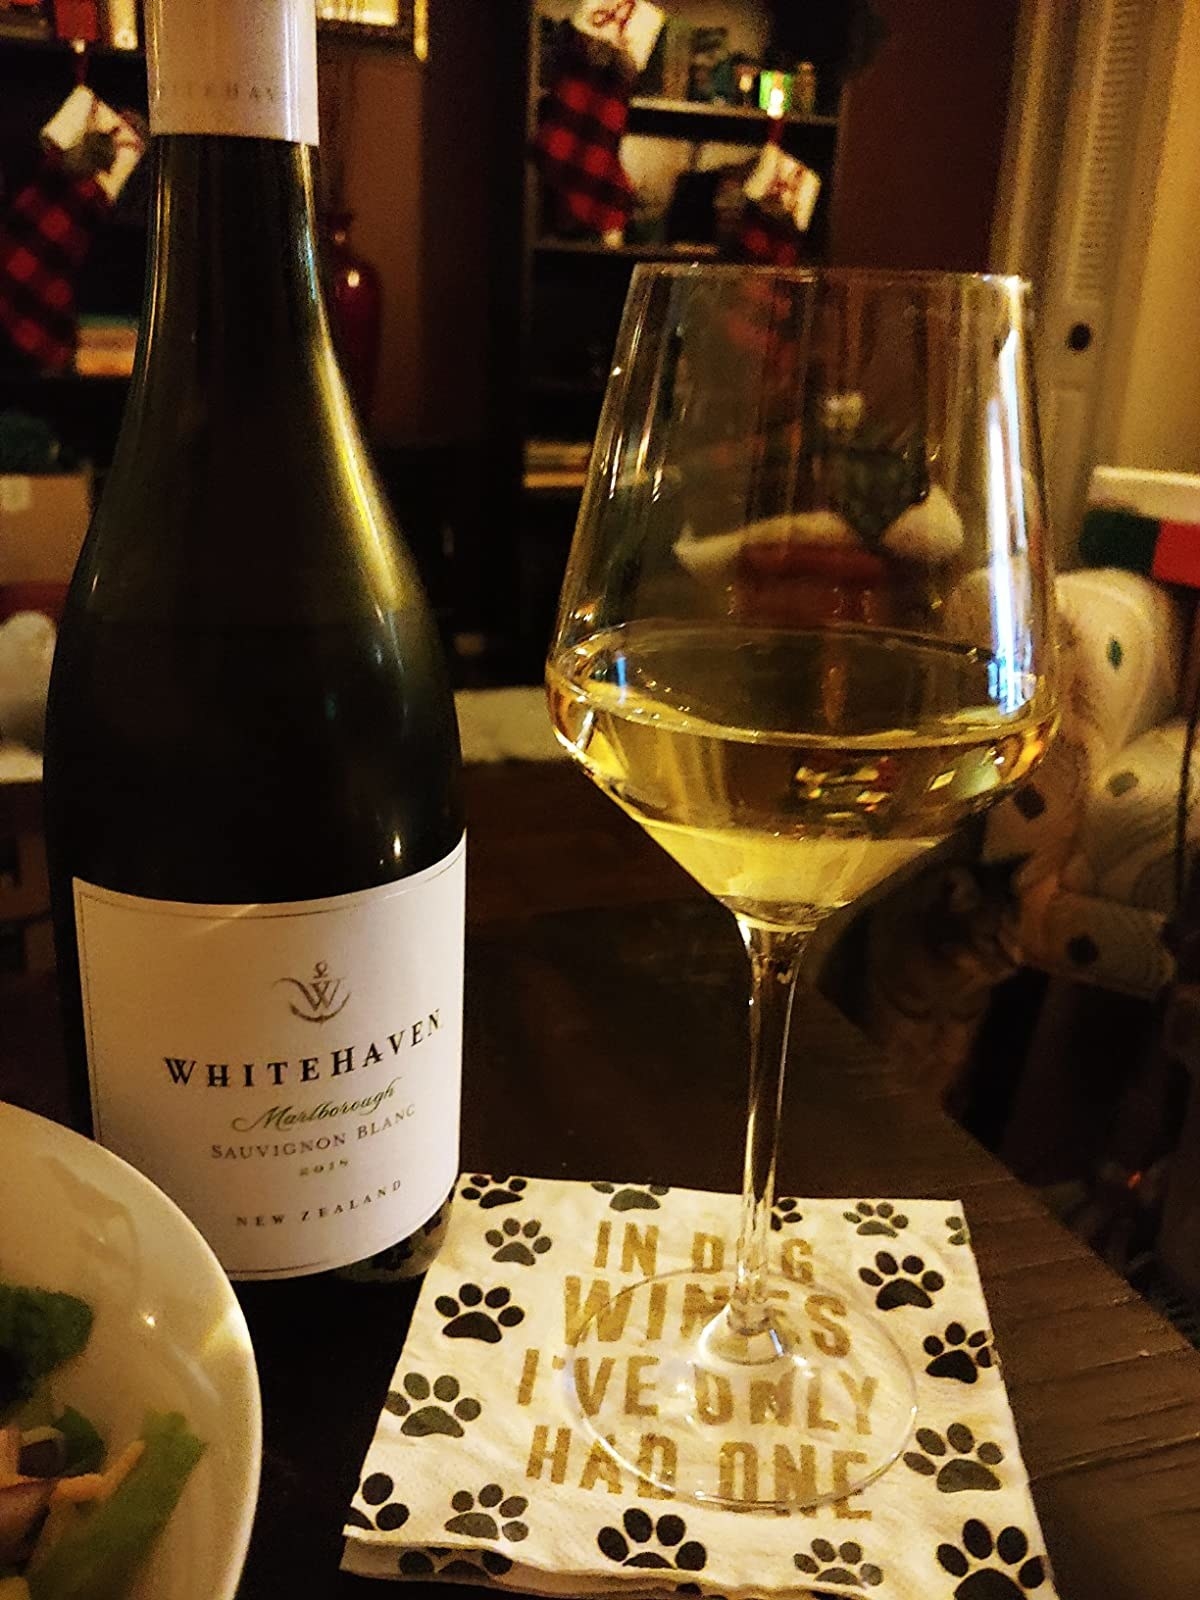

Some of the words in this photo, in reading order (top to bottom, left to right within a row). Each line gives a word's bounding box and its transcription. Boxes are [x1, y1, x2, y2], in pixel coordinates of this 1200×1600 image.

[164, 1008, 443, 1089] WHITEHAVEN
[211, 1132, 347, 1160] SAUVIGNON
[356, 1103, 416, 1141] BLANC
[231, 1076, 402, 1133] Marlborough
[235, 1214, 286, 1227] NEW
[300, 1179, 402, 1222] ZEALAND
[593, 1220, 660, 1277] IN
[691, 1231, 814, 1286] DG
[517, 1348, 660, 1417] I'VE
[693, 1367, 880, 1435] ONLY
[525, 1425, 680, 1500] HAD
[717, 1441, 873, 1521] ONE
